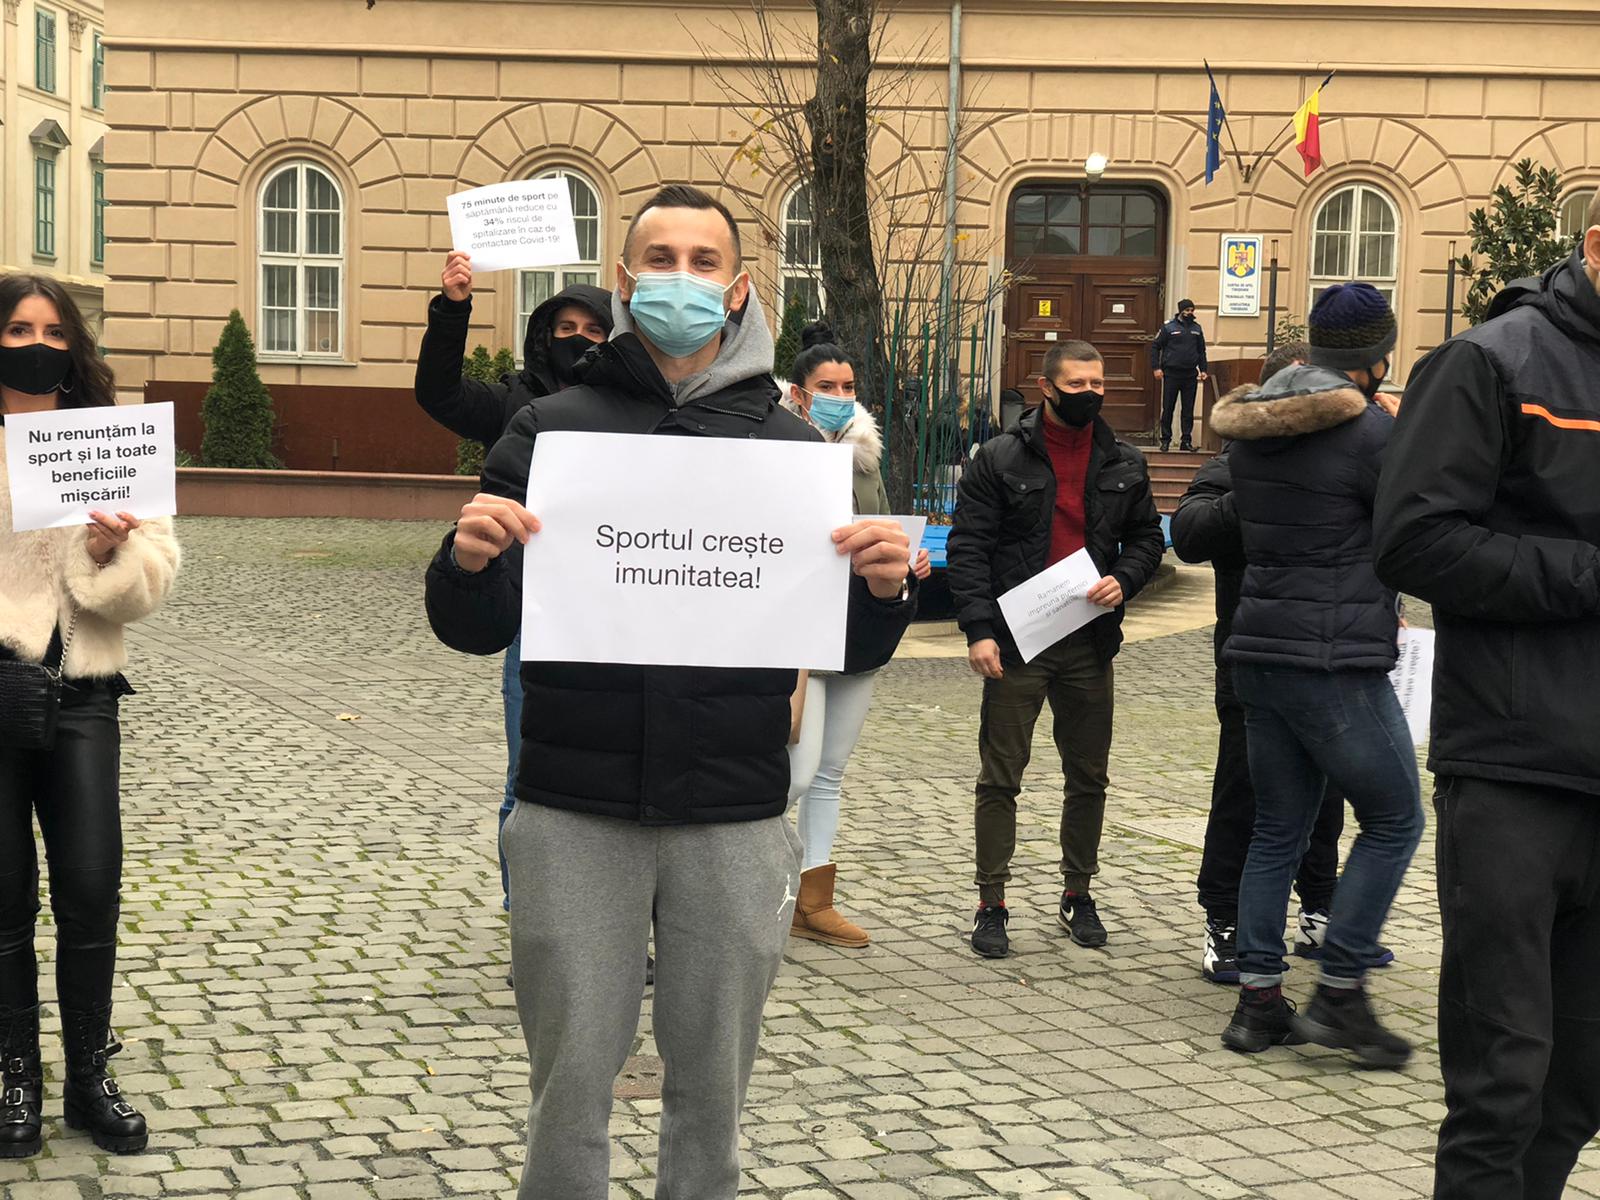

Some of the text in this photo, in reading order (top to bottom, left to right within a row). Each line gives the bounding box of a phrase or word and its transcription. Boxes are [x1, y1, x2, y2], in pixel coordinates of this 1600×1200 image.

[461, 192, 558, 209] 75 minute de sport pe
[515, 203, 544, 212] reduce
[546, 203, 557, 211] cu
[483, 217, 504, 227] 34%
[506, 215, 530, 224] riscul
[473, 227, 516, 239] spitalizare
[545, 224, 556, 232] de
[471, 238, 518, 250] contactare
[28, 422, 155, 443] Nu renunțăm la
[28, 443, 157, 466] sport și la toate
[52, 465, 137, 483] beneficiile
[61, 485, 130, 504] mișcării!
[596, 524, 784, 559] Sportul crește
[615, 561, 761, 589] imunitatea!
